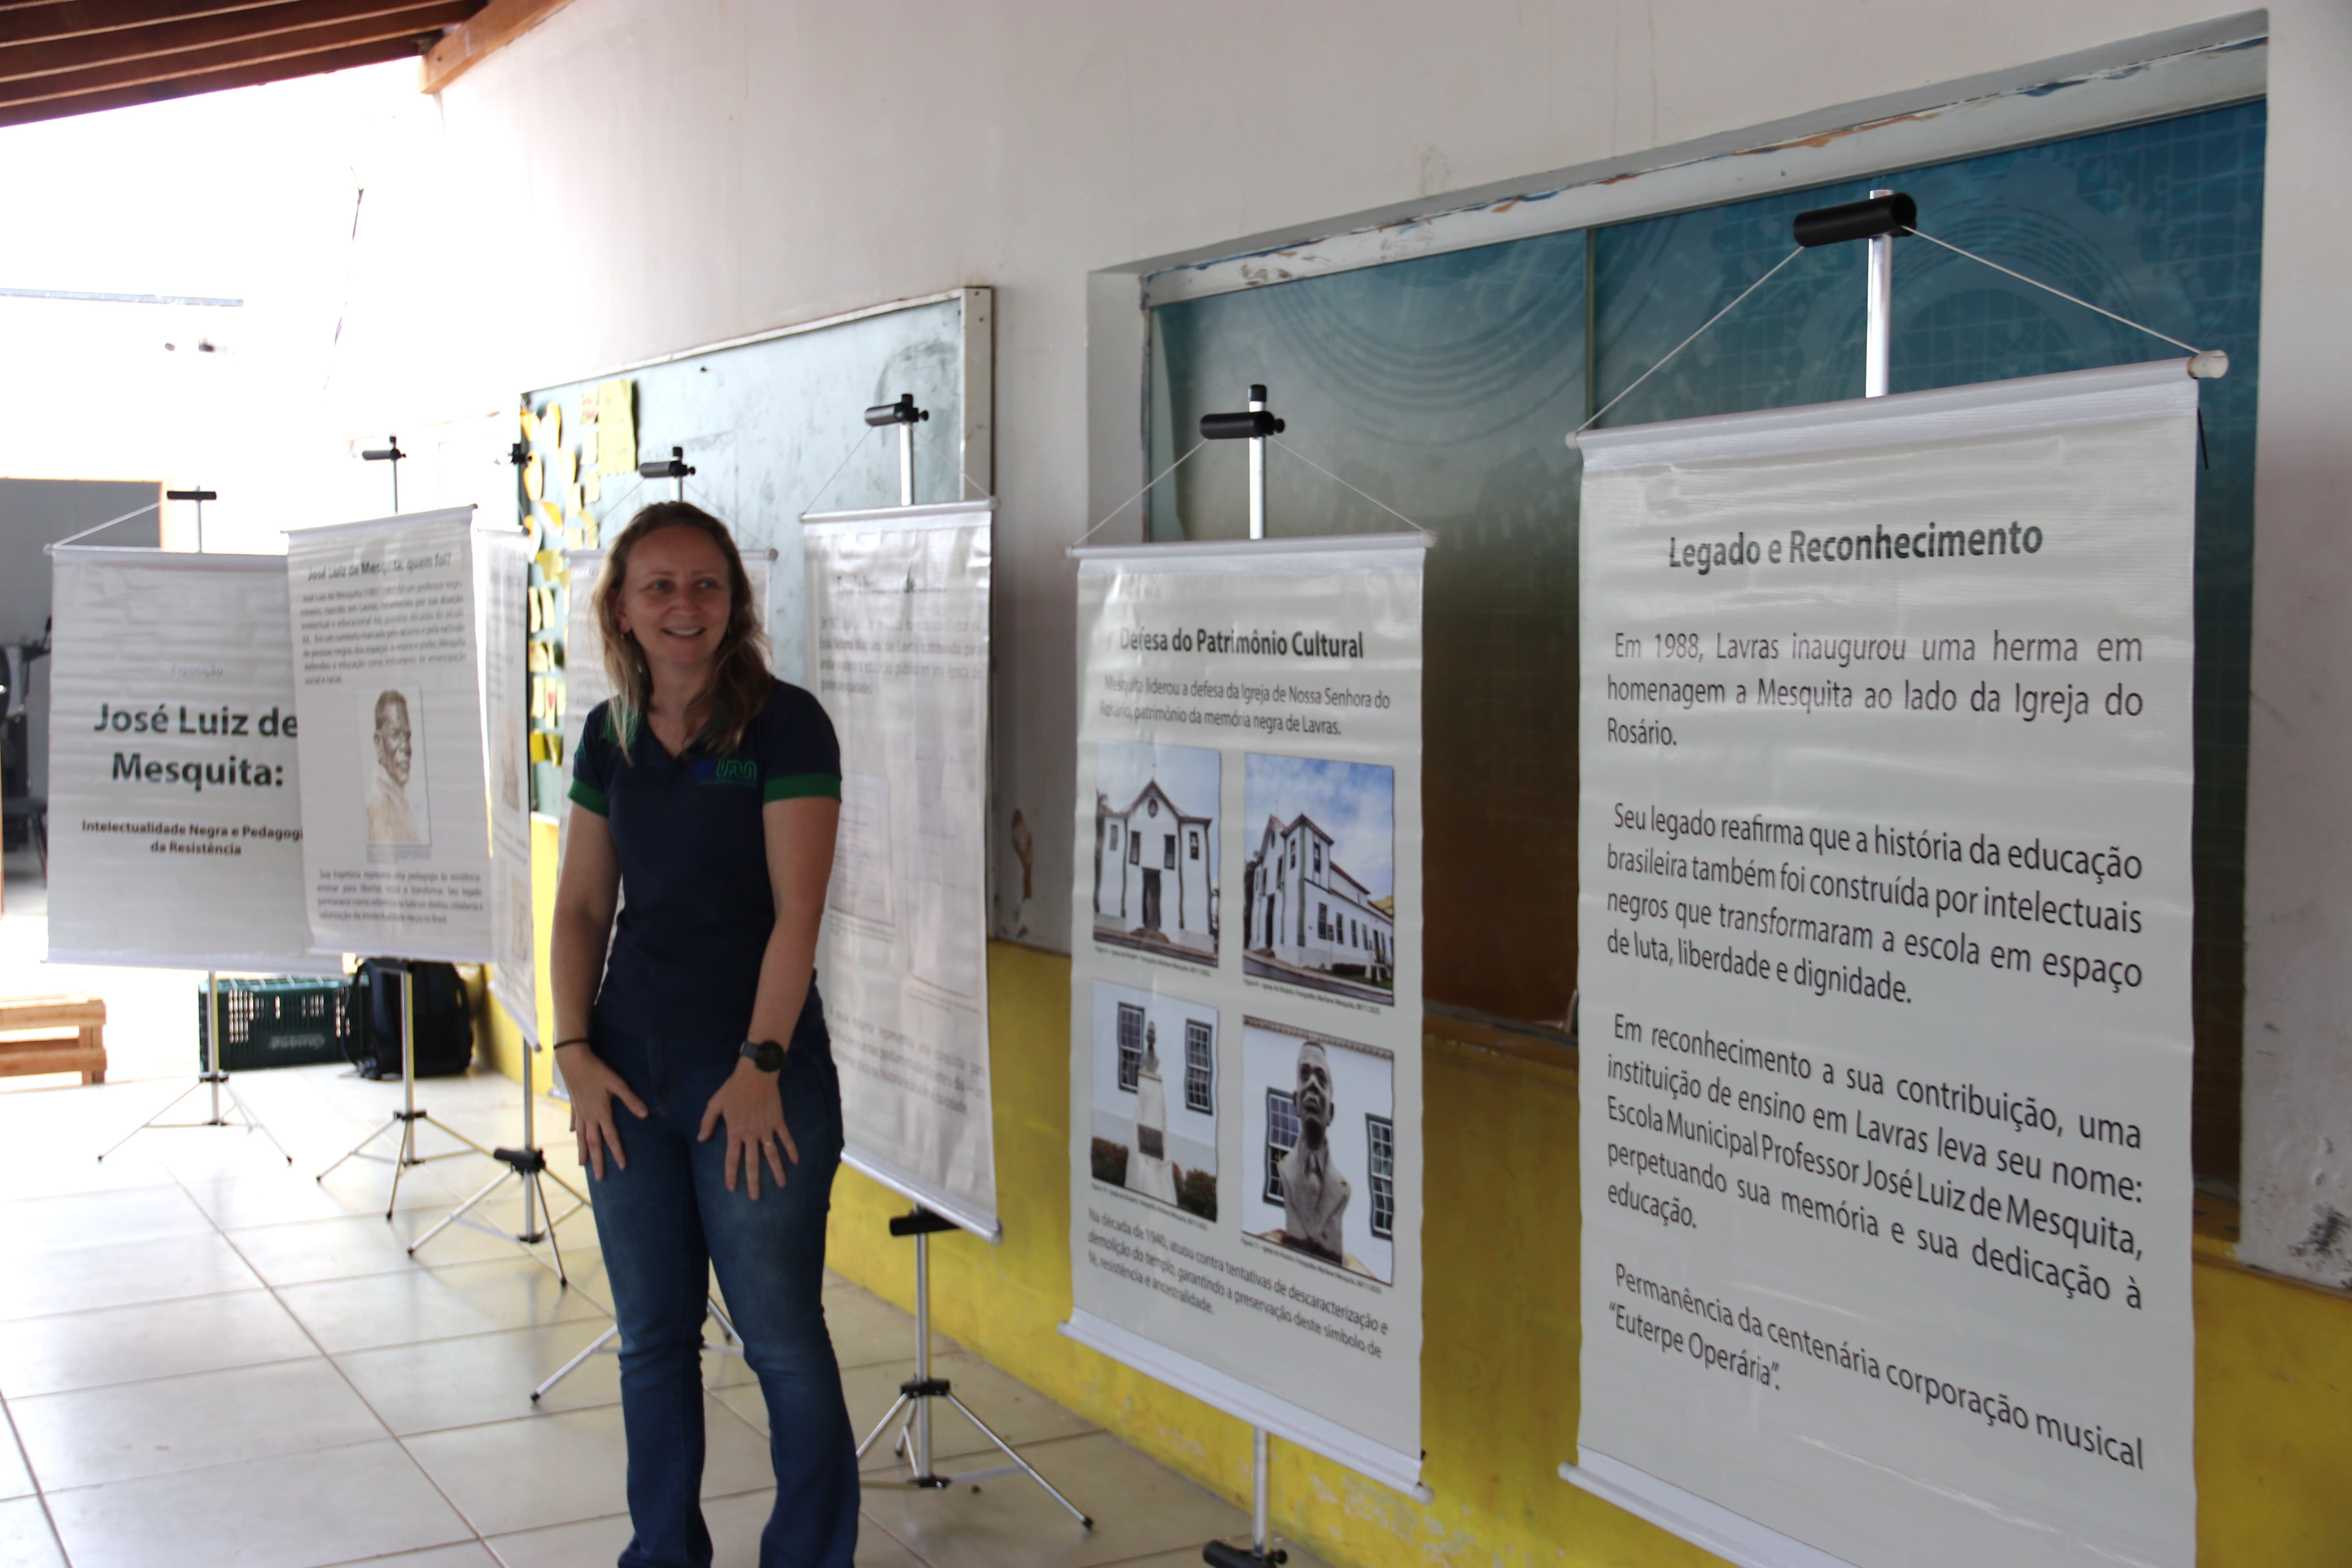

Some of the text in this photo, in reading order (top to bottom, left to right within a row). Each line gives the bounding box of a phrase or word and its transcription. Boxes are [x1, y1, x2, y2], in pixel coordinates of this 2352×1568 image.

[1669, 520, 2043, 575] Legado e Reconhecimento
[1120, 626, 1364, 658] Defesa do Patrimônio Cultural
[1615, 629, 2142, 668] Em 1988, Lavras inaugurou uma herma em
[1144, 676, 1180, 696] liderou
[1181, 682, 1189, 696] a
[1190, 679, 1225, 699] defesa
[1226, 682, 1240, 699] da
[1241, 683, 1271, 705] Igreja
[1272, 684, 1287, 702] de
[1289, 685, 1323, 704] Nossa
[1324, 686, 1372, 708] Senhora
[1374, 689, 1391, 709] do
[1607, 673, 2143, 723] homenagem a Mesquita ao lado da Igreja do
[93, 703, 298, 738] José Luiz de
[1134, 705, 1187, 723] patrimônio
[1188, 707, 1203, 725] da
[1204, 710, 1252, 728] memória
[1253, 715, 1284, 735] negra
[1285, 713, 1301, 733] de
[1302, 715, 1342, 735] Lavras.
[1608, 717, 1677, 746] Rosário.
[112, 751, 283, 792] Mesquita:
[82, 820, 186, 835] Intelectualidade
[189, 823, 228, 839] Negra
[231, 828, 239, 837] e
[150, 840, 242, 855] da Resistência
[1614, 802, 2142, 884] Seu legado reafirma que a história da educação
[1607, 842, 2142, 934] brasileira também foi construída por intelectuais
[1607, 892, 2142, 993] negros que transformaram a escola em espaço
[1607, 927, 1911, 1004] de luta, liberdade e dignidade.
[1615, 1013, 2141, 1149] Em reconhecimento a sua contribuição, uma
[1608, 1053, 2142, 1203] instituição de ensino em Lavras leva seu nome:
[1607, 1094, 2142, 1261] Escola Municipal Professor José Luiz de Mesquita,
[1608, 1181, 1697, 1229] educação.
[1608, 1143, 2142, 1310] perpetuando sua memória e sua dedicação à
[1088, 1230, 1382, 1358] demolição do templo, garantindo a preservação deste símbolo de
[1100, 1257, 1143, 1284] resistência
[1145, 1276, 1150, 1287] e
[1101, 1214, 1131, 1236] década
[1133, 1225, 1143, 1240] de
[1170, 1240, 1194, 1260] atuou
[1196, 1251, 1224, 1272] contra
[1225, 1262, 1272, 1290] tentativas
[1274, 1278, 1287, 1296] de
[1288, 1287, 1377, 1331] descaracterização
[1380, 1322, 1389, 1336] e
[1615, 1262, 2143, 1470] Permanência da centenária corporação musical
